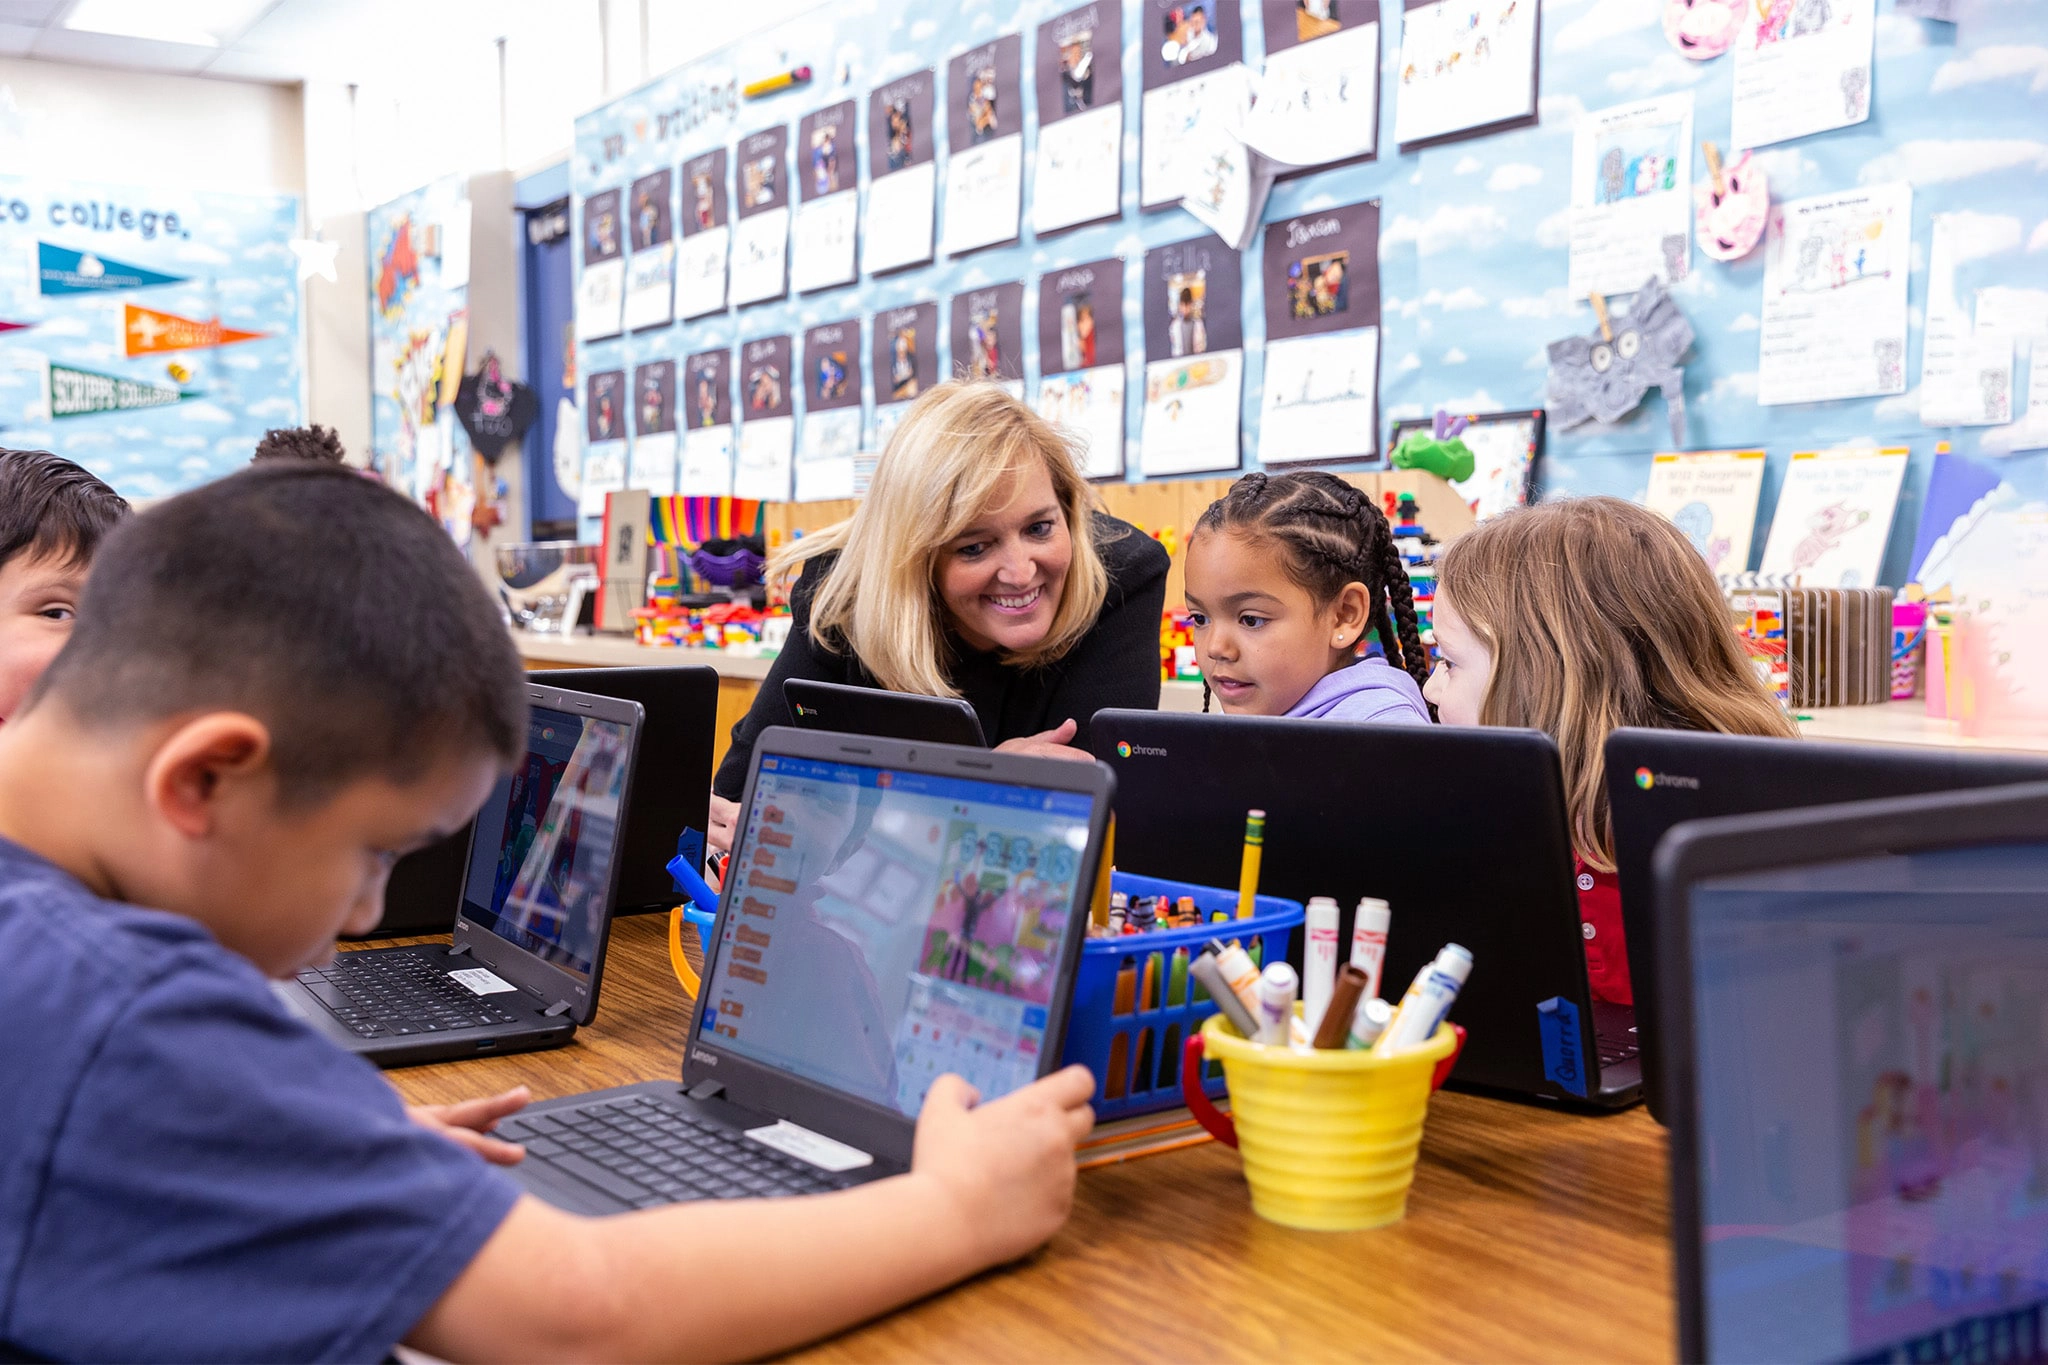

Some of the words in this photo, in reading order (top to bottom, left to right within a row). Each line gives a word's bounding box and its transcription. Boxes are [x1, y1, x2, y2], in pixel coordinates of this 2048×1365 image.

[53, 368, 117, 413] SCRIPPS
[1132, 744, 1167, 757] chrome
[1655, 772, 1699, 789] chrome
[691, 1046, 718, 1067] Lenovo
